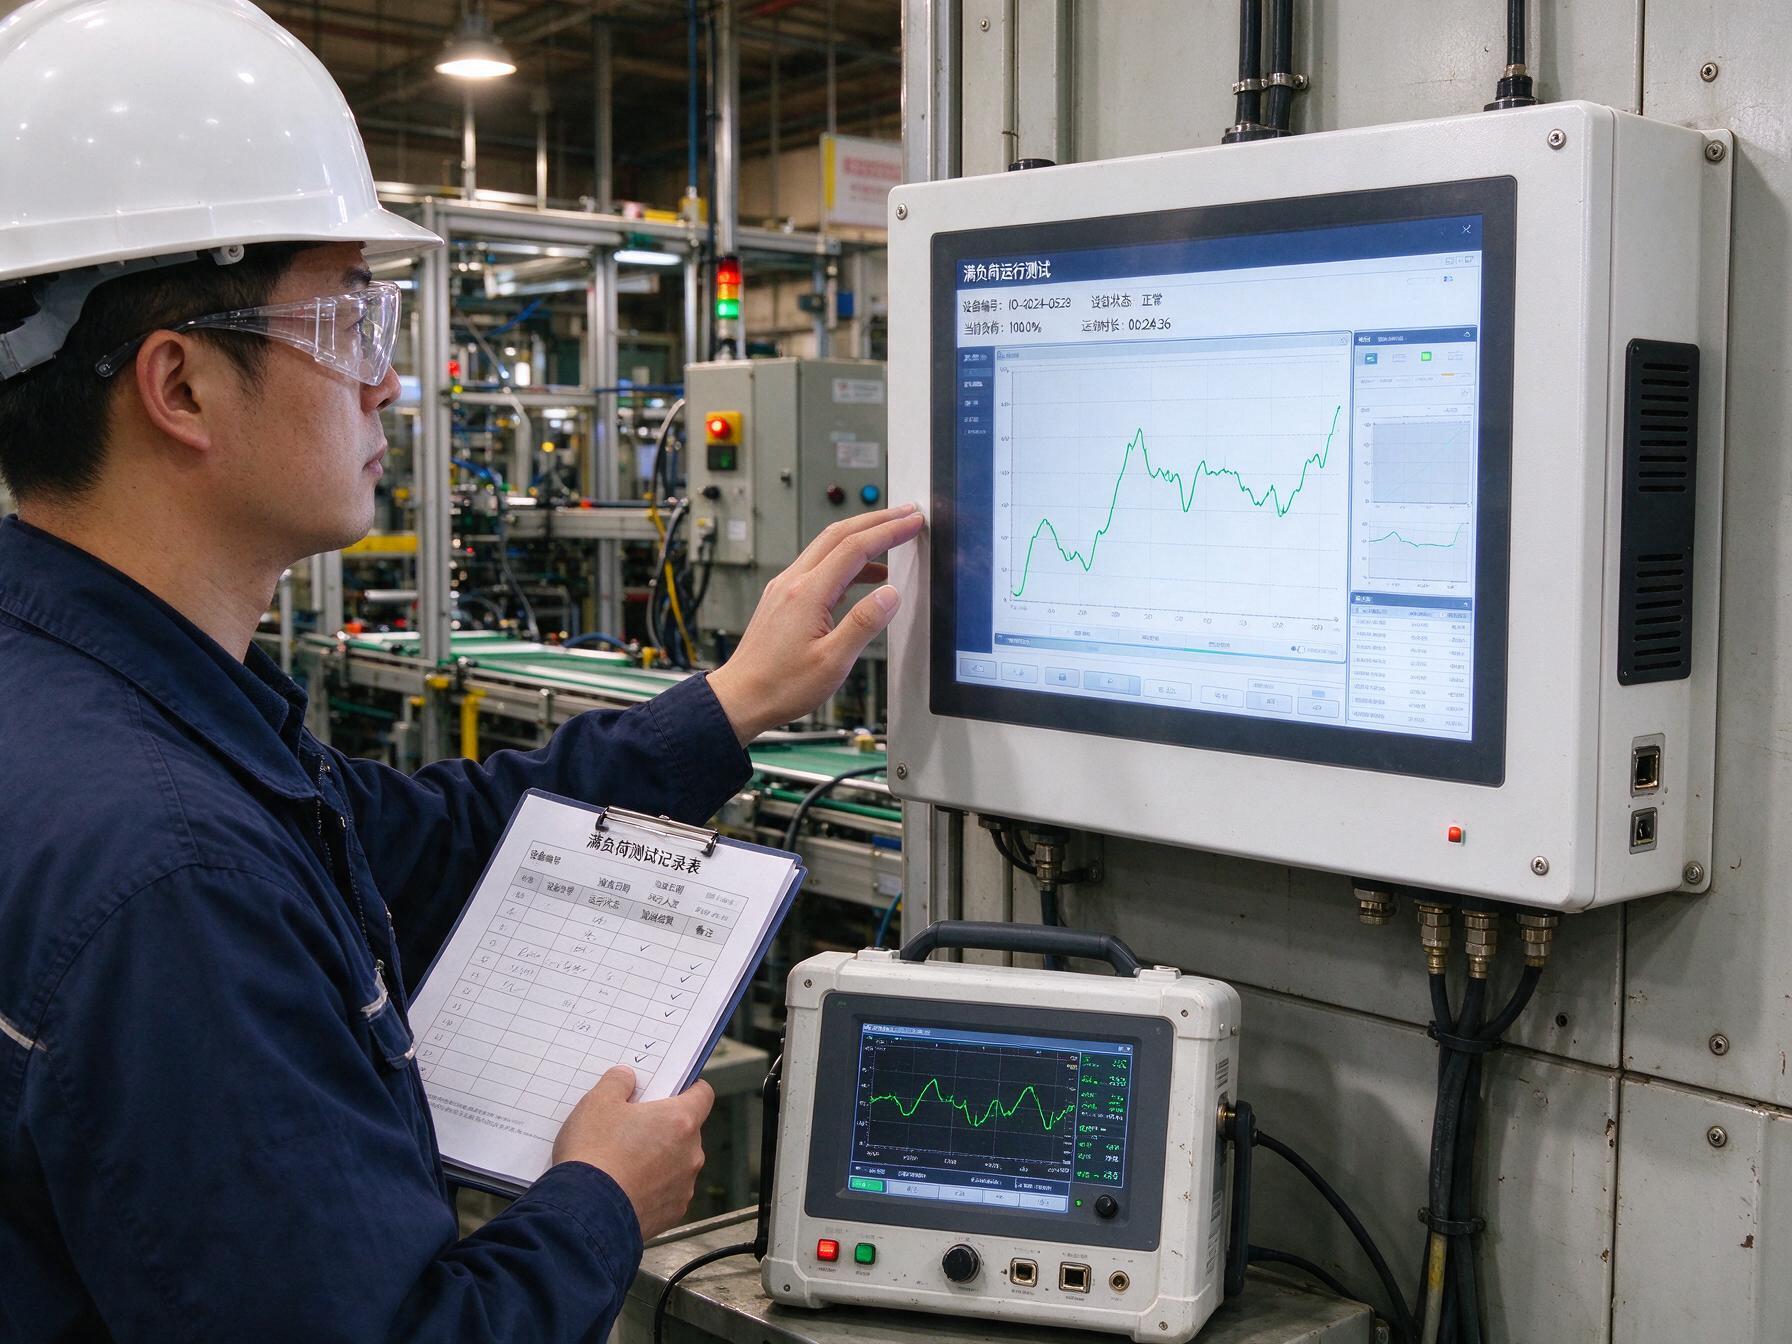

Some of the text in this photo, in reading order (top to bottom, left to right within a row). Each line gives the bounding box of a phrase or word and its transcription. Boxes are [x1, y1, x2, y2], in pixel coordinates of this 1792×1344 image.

[963, 259, 1051, 283] 满负荷运行测试
[586, 832, 702, 875] 满负荷测试记录表
